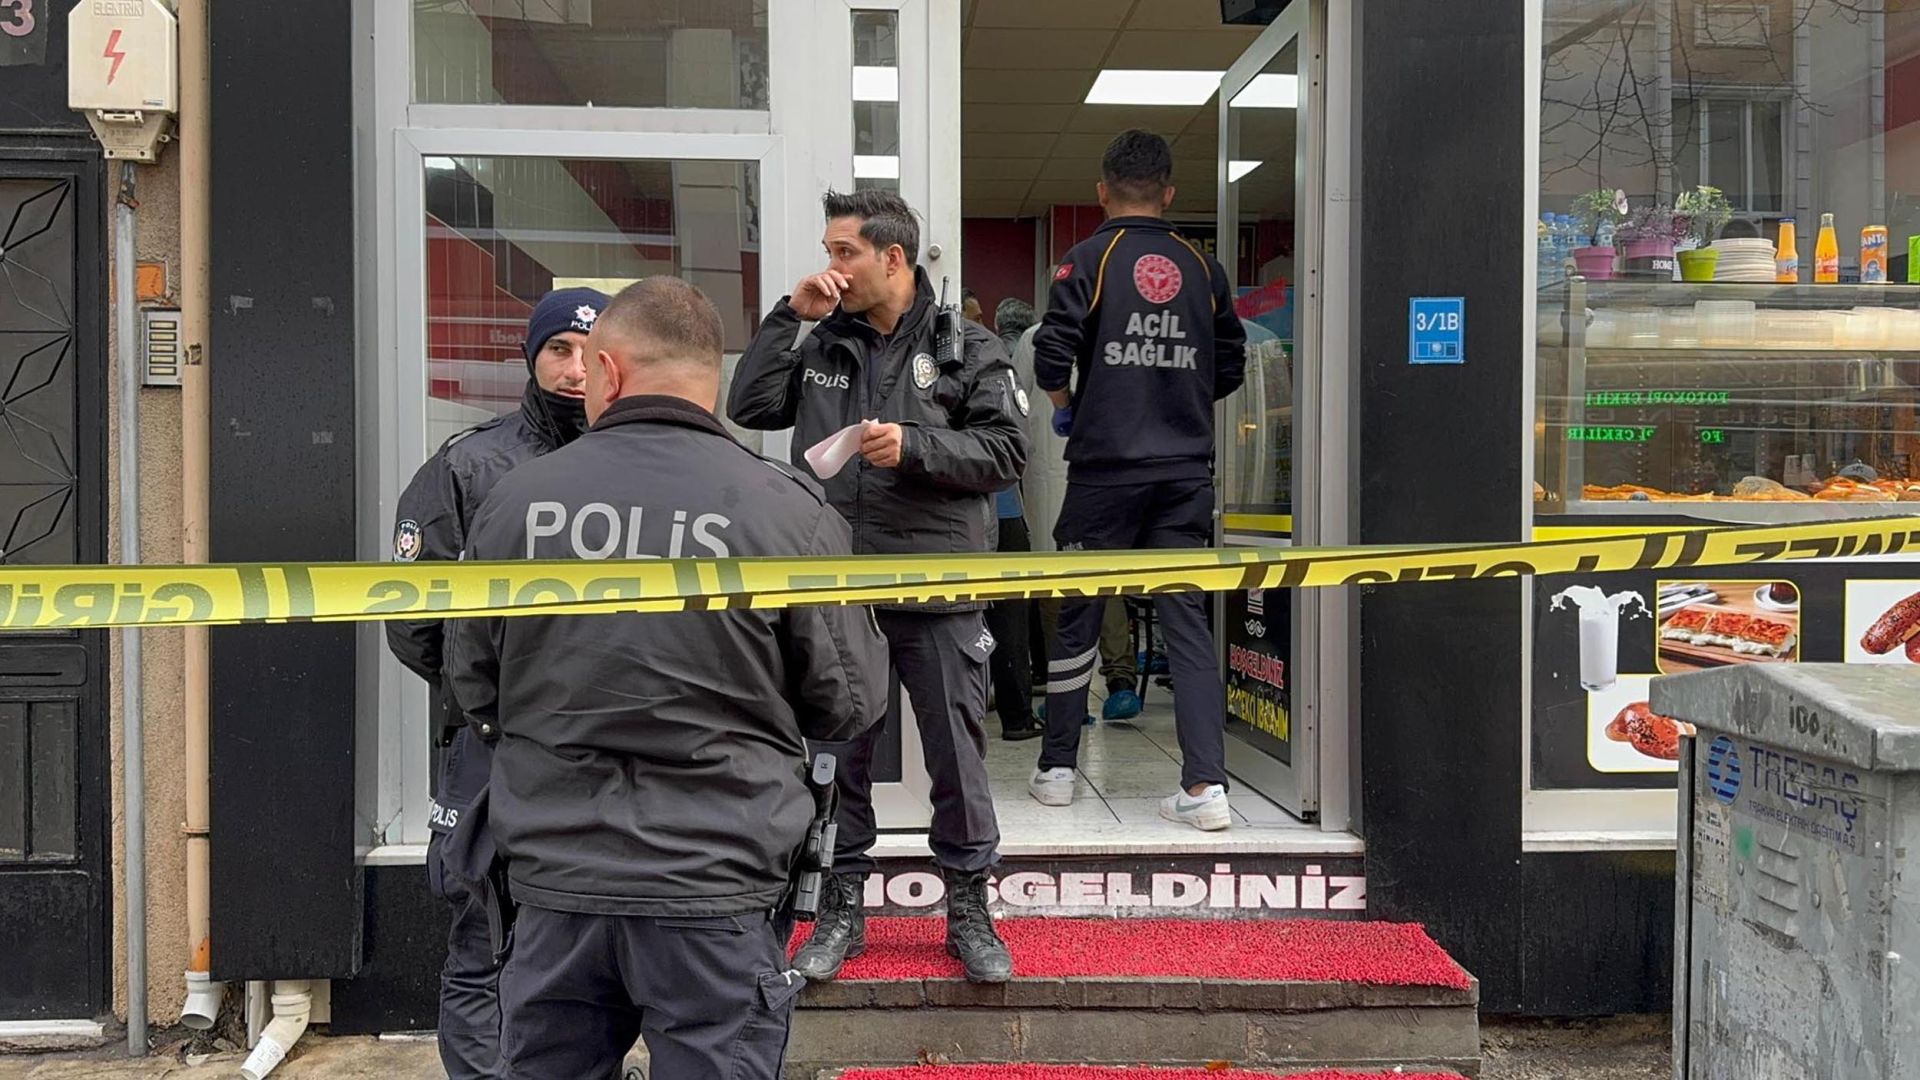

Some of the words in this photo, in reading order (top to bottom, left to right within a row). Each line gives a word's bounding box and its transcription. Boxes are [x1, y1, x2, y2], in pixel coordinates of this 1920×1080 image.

[1861, 233, 1887, 246] ANT
[1416, 312, 1459, 331] 3/1B
[1104, 338, 1198, 370] SAĞLIK
[863, 863, 1367, 910] OGELDİNİZ
